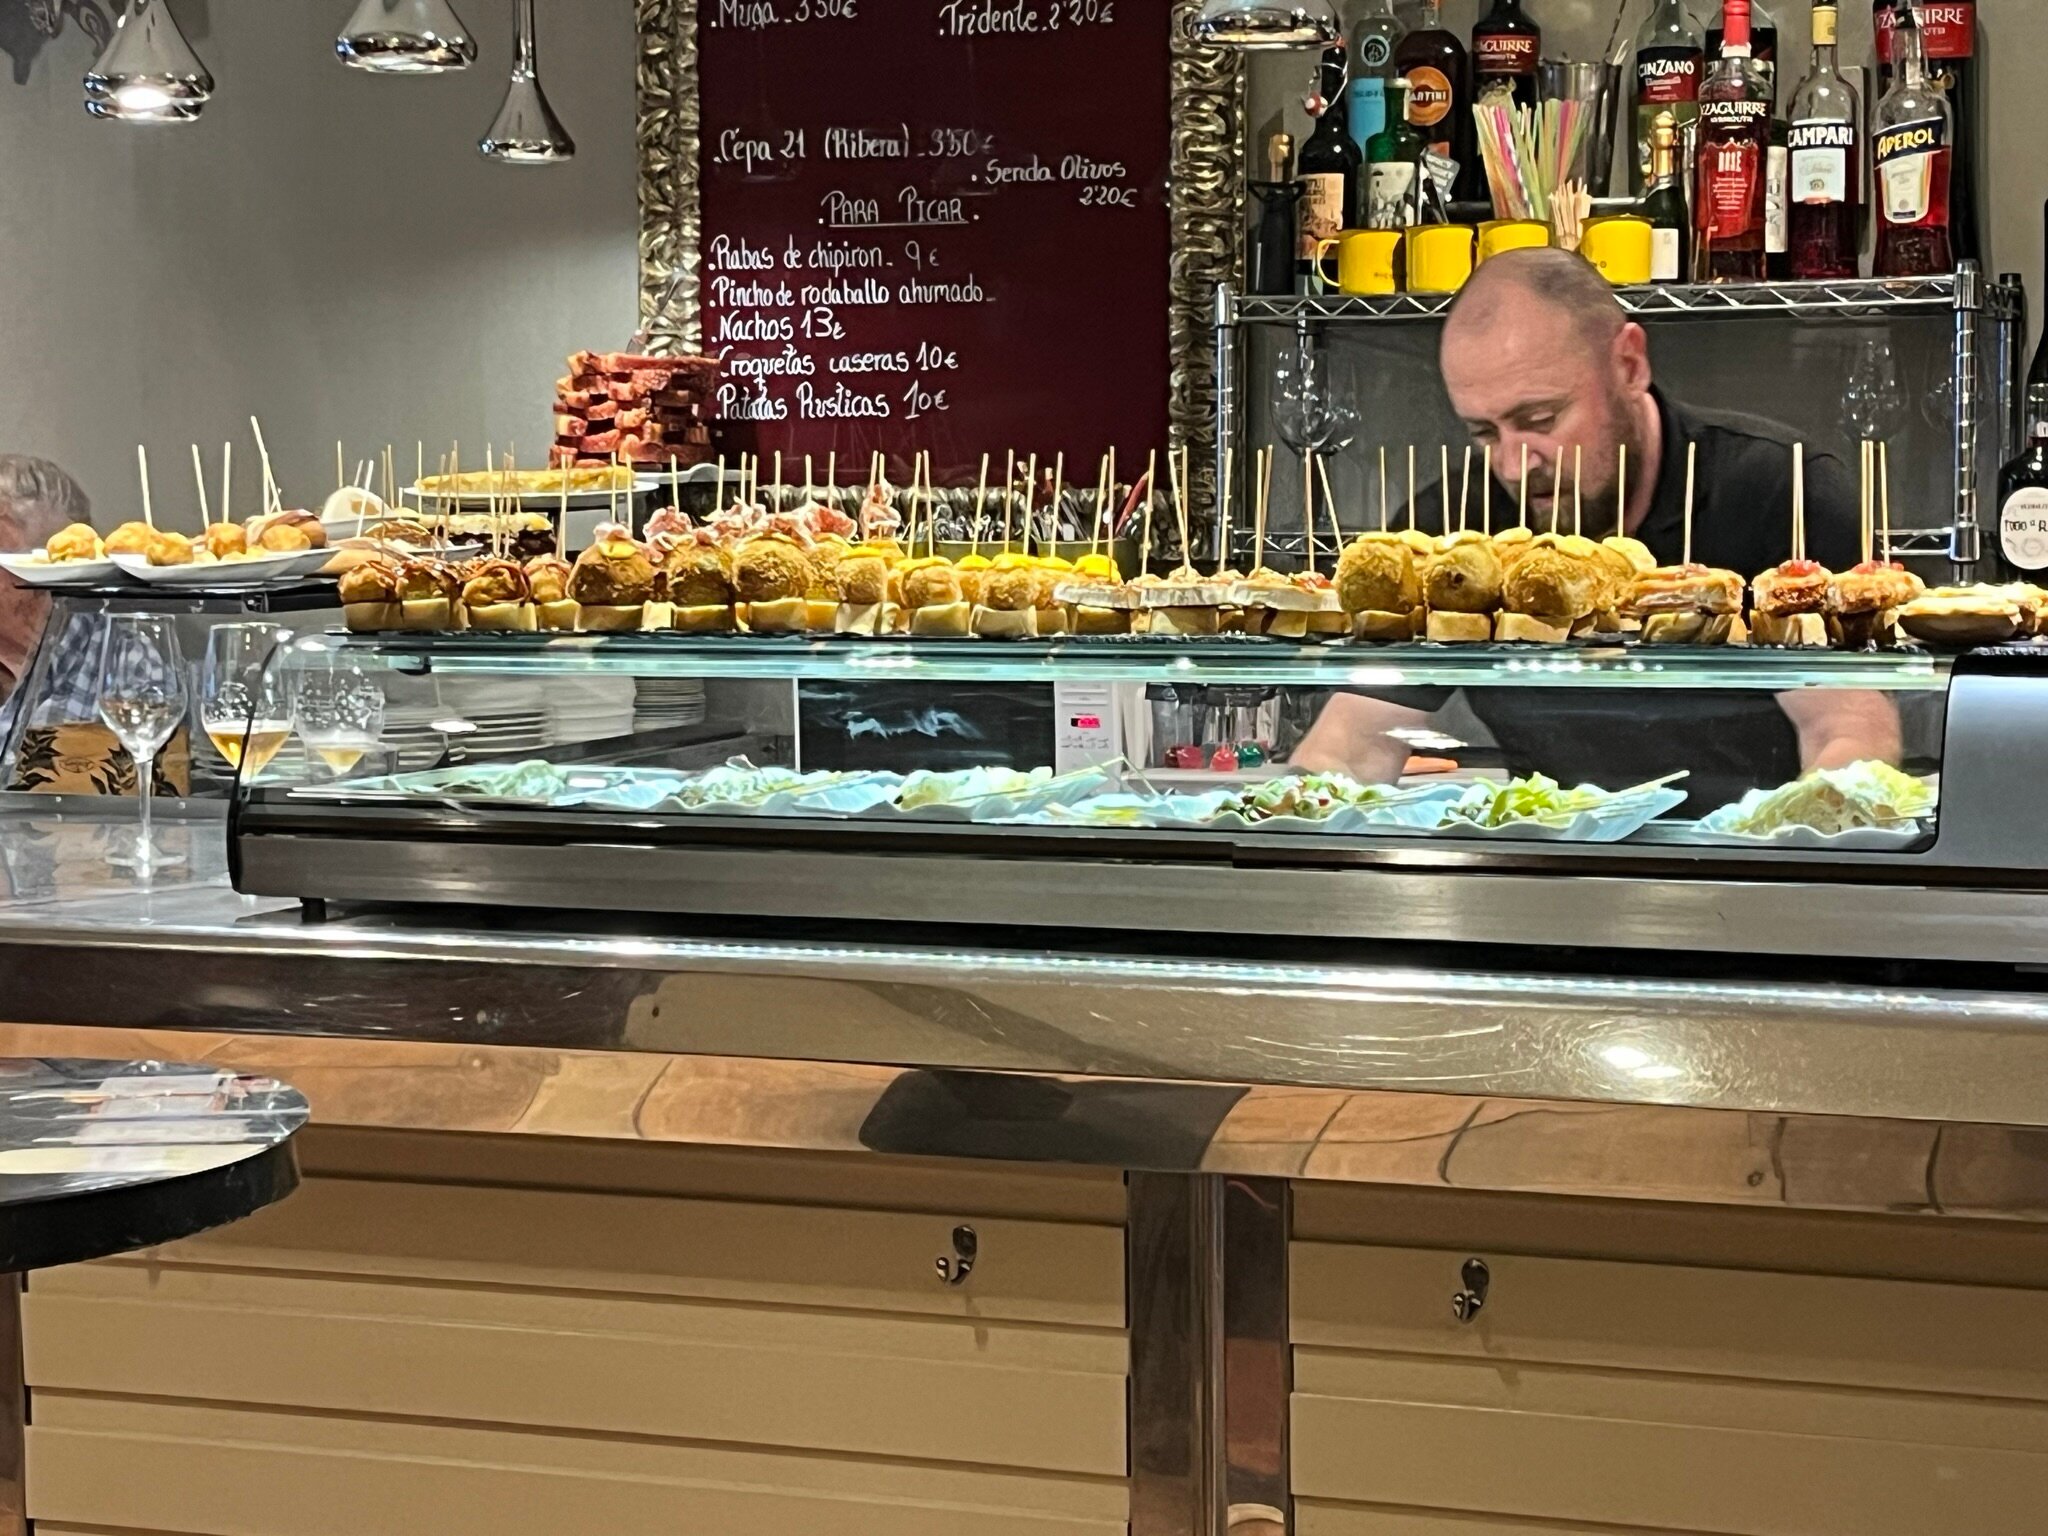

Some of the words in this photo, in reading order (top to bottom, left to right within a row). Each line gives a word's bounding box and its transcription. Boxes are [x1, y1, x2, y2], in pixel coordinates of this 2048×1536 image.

[939, 0, 1038, 36] Tridente
[1639, 59, 1695, 77] CINZANO
[1409, 91, 1447, 101] ARTINI
[780, 128, 806, 158] 21
[1788, 126, 1853, 148] CAMPARI
[1878, 128, 1936, 160] APEROL
[985, 154, 1055, 184] Senda
[1060, 154, 1126, 179] Olivos
[821, 190, 880, 225] PARA
[899, 185, 967, 223] PICAR
[710, 233, 774, 270] Rabas
[783, 233, 803, 269] de
[711, 275, 774, 308] Pincho
[775, 280, 796, 307] de
[801, 277, 890, 306] rodaballo
[899, 272, 983, 305] ahumado
[719, 309, 794, 341] Nachos
[719, 344, 816, 392] Croquetas
[829, 351, 910, 373] caseras
[916, 341, 959, 371] 10€
[716, 383, 788, 421] Patatas
[903, 379, 950, 420] 10€
